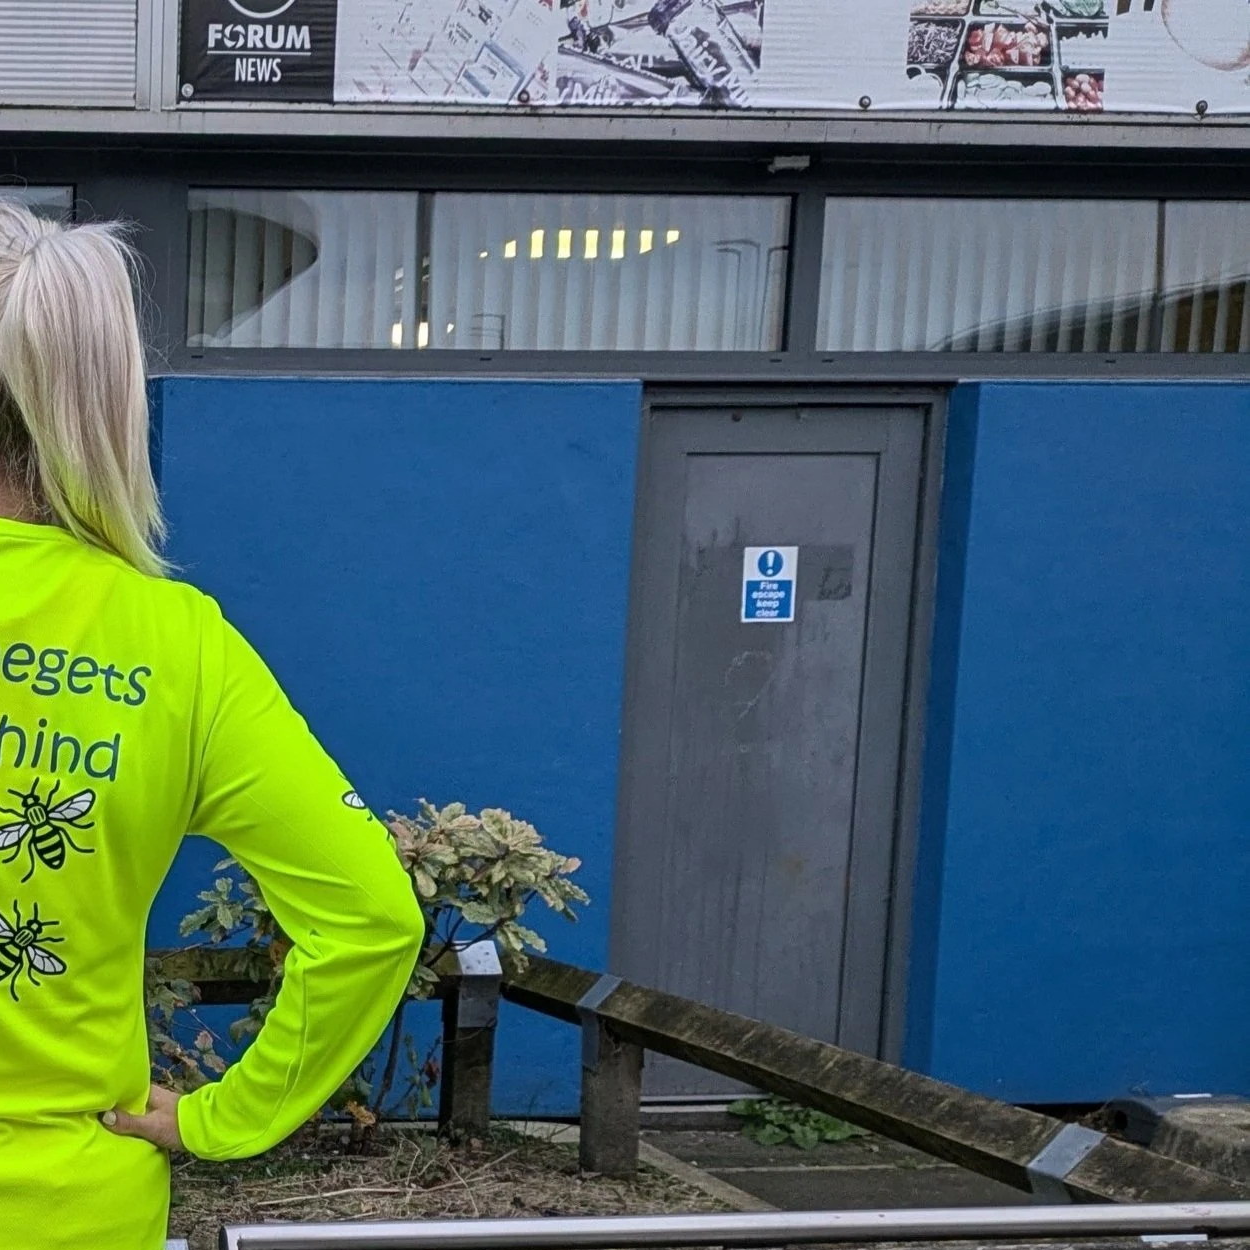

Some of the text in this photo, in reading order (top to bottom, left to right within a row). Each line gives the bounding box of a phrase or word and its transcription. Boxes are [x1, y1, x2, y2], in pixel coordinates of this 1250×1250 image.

[207, 23, 312, 50] FORUM
[235, 57, 282, 83] NEWS
[759, 581, 779, 590] Fire
[751, 590, 786, 600] escape
[756, 600, 780, 609] keep
[755, 608, 780, 617] clear
